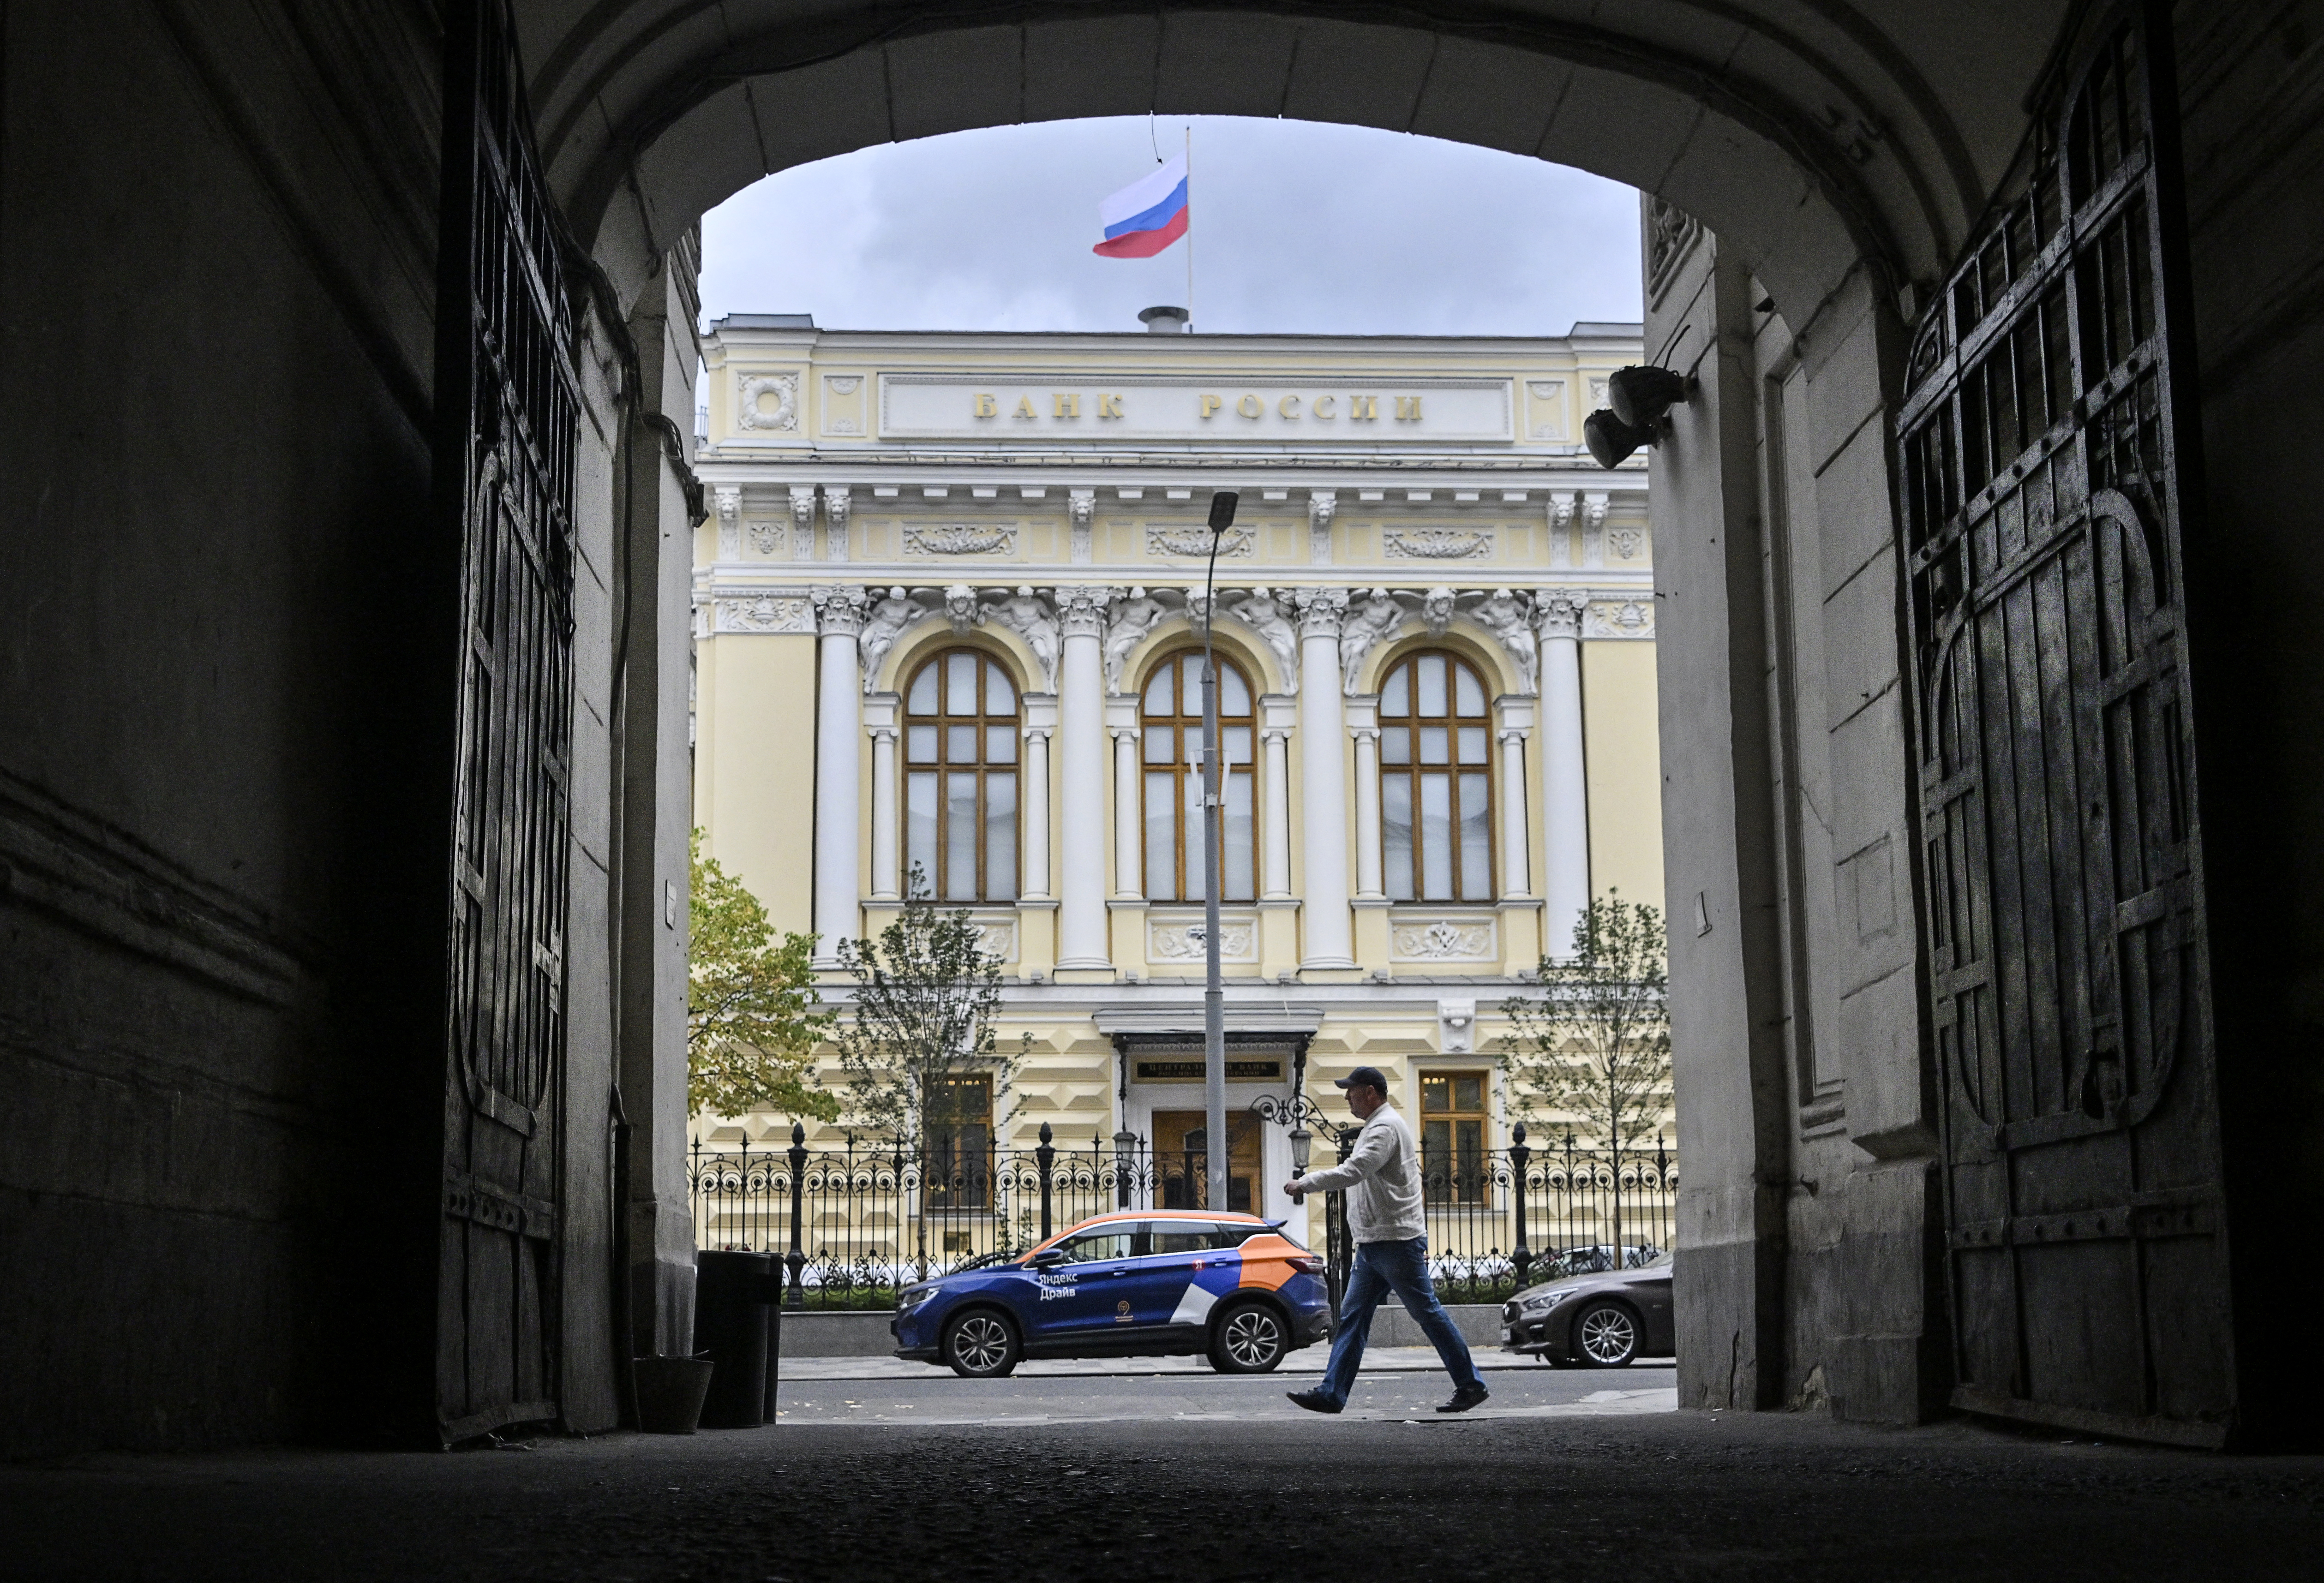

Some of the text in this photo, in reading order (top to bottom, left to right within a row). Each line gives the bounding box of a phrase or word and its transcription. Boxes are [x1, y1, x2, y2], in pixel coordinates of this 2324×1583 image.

[973, 393, 1424, 420] БАНК РОССИИ
[1195, 1260, 1202, 1269] Я
[1039, 1273, 1078, 1285] Яндекс
[1040, 1286, 1076, 1301] Драйв
